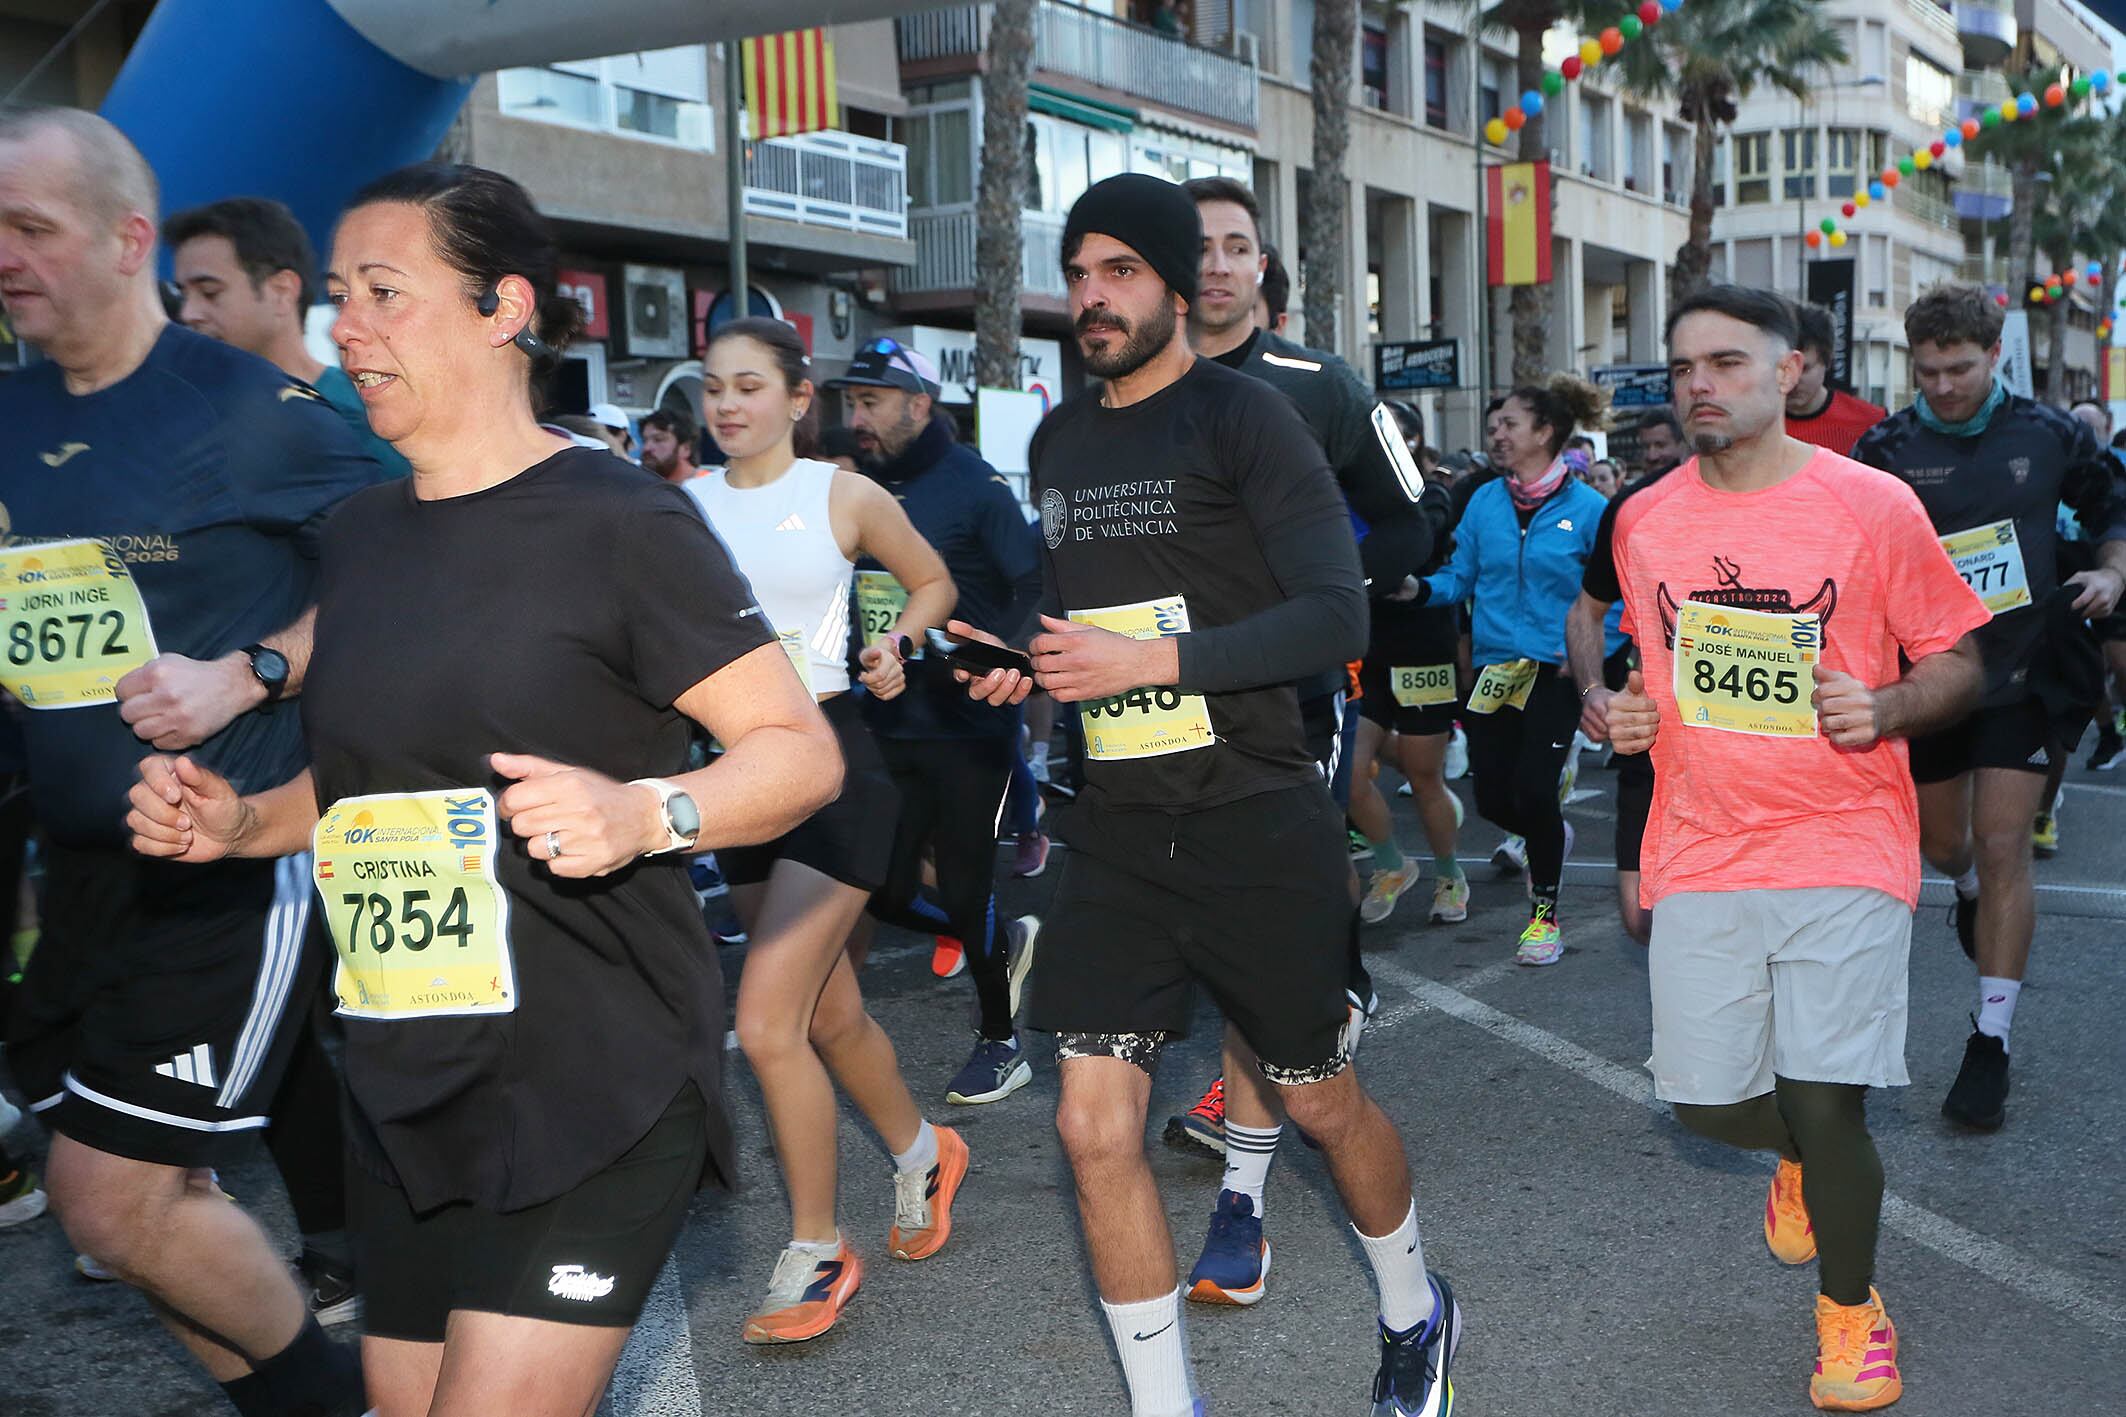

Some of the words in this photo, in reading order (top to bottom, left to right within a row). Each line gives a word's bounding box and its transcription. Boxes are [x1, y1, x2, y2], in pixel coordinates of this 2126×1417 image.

[1073, 480, 1176, 503] UNIVERSITAT
[1073, 499, 1177, 523] POLITÈCNICA
[1075, 526, 1094, 541] DE
[1100, 518, 1179, 538] VALÈNCIA
[124, 550, 179, 563] 2026
[20, 594, 64, 612] JØRN
[70, 587, 110, 605] INGE
[1756, 594, 1787, 604] 2024
[8, 609, 129, 666] 8672
[1705, 624, 1733, 637] 10K
[1791, 619, 1817, 650] 10K
[1698, 641, 1732, 657] JOSÉ
[1736, 648, 1795, 664] MANUEL
[1402, 670, 1449, 690] 8508
[1694, 659, 1799, 704] 8465
[1139, 736, 1188, 751] ASTONDOA
[446, 796, 487, 849] 10K
[343, 828, 378, 844] 10K
[353, 860, 437, 880] CRISTINA
[342, 886, 474, 954] 7854
[409, 991, 474, 1006] ASTONDOA
